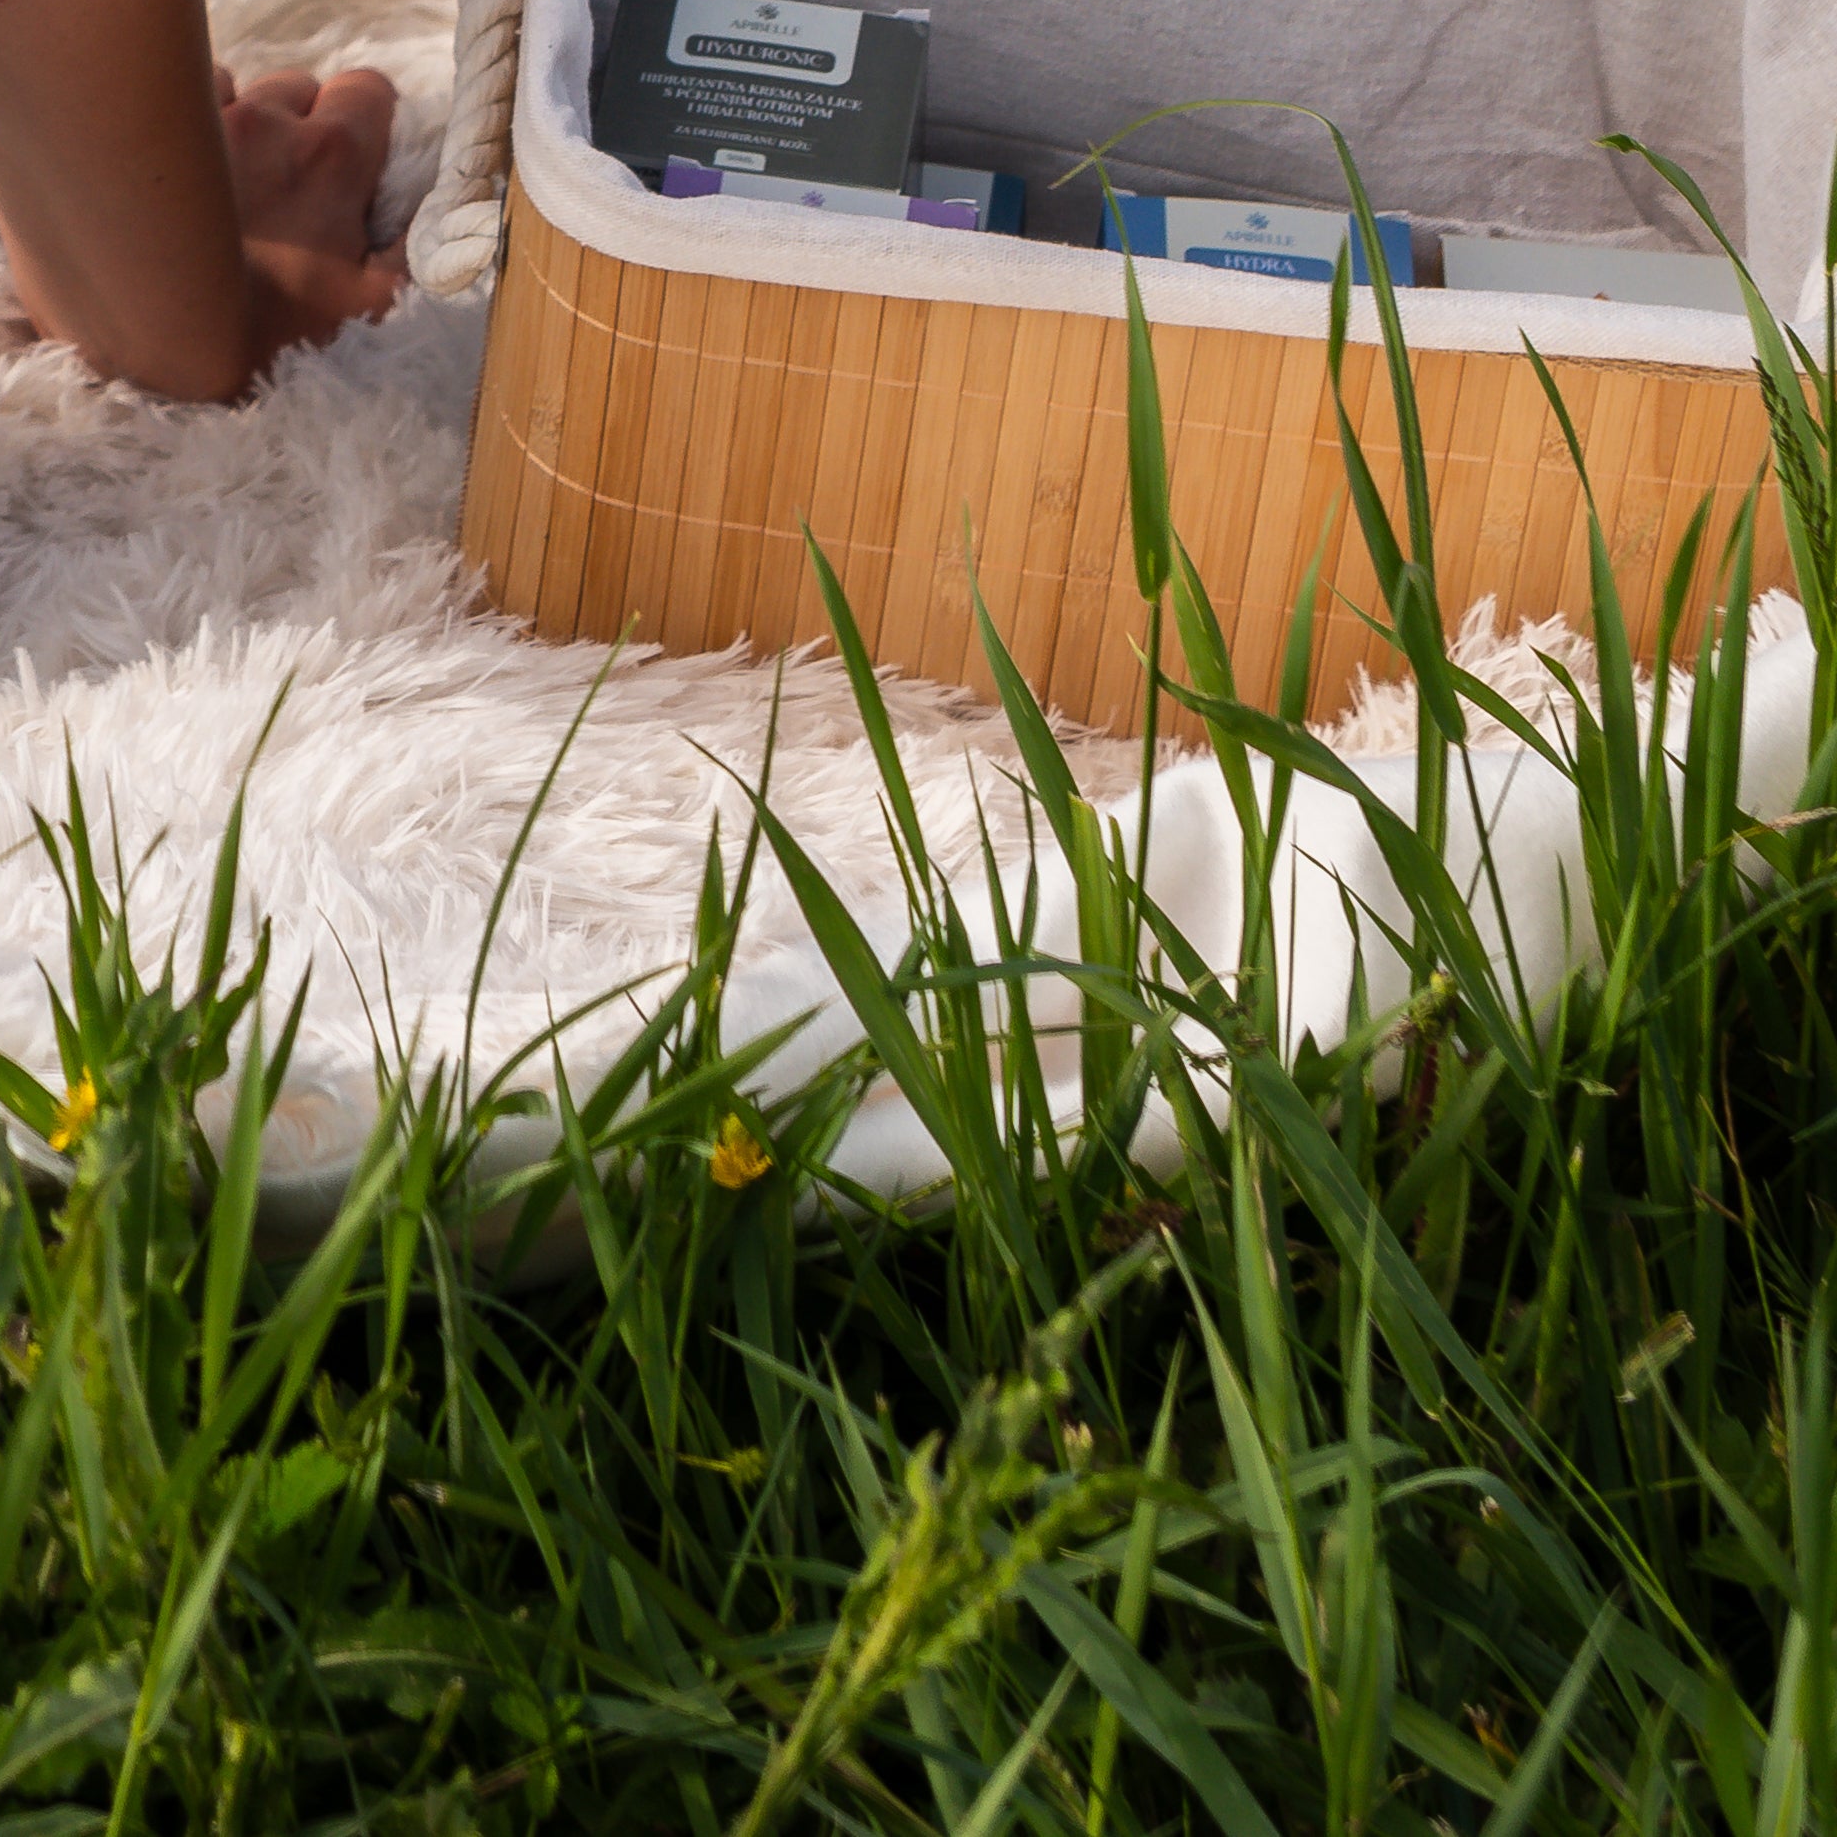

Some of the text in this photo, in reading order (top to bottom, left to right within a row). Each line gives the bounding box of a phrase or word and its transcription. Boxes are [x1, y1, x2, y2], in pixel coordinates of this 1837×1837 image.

[697, 39, 825, 67] HYALURONIC
[748, 84, 802, 101] KREMA
[803, 91, 826, 106] ZA
[826, 95, 863, 112] LICE
[755, 98, 835, 120] OTROVOM
[1224, 253, 1296, 275] HYDRA
